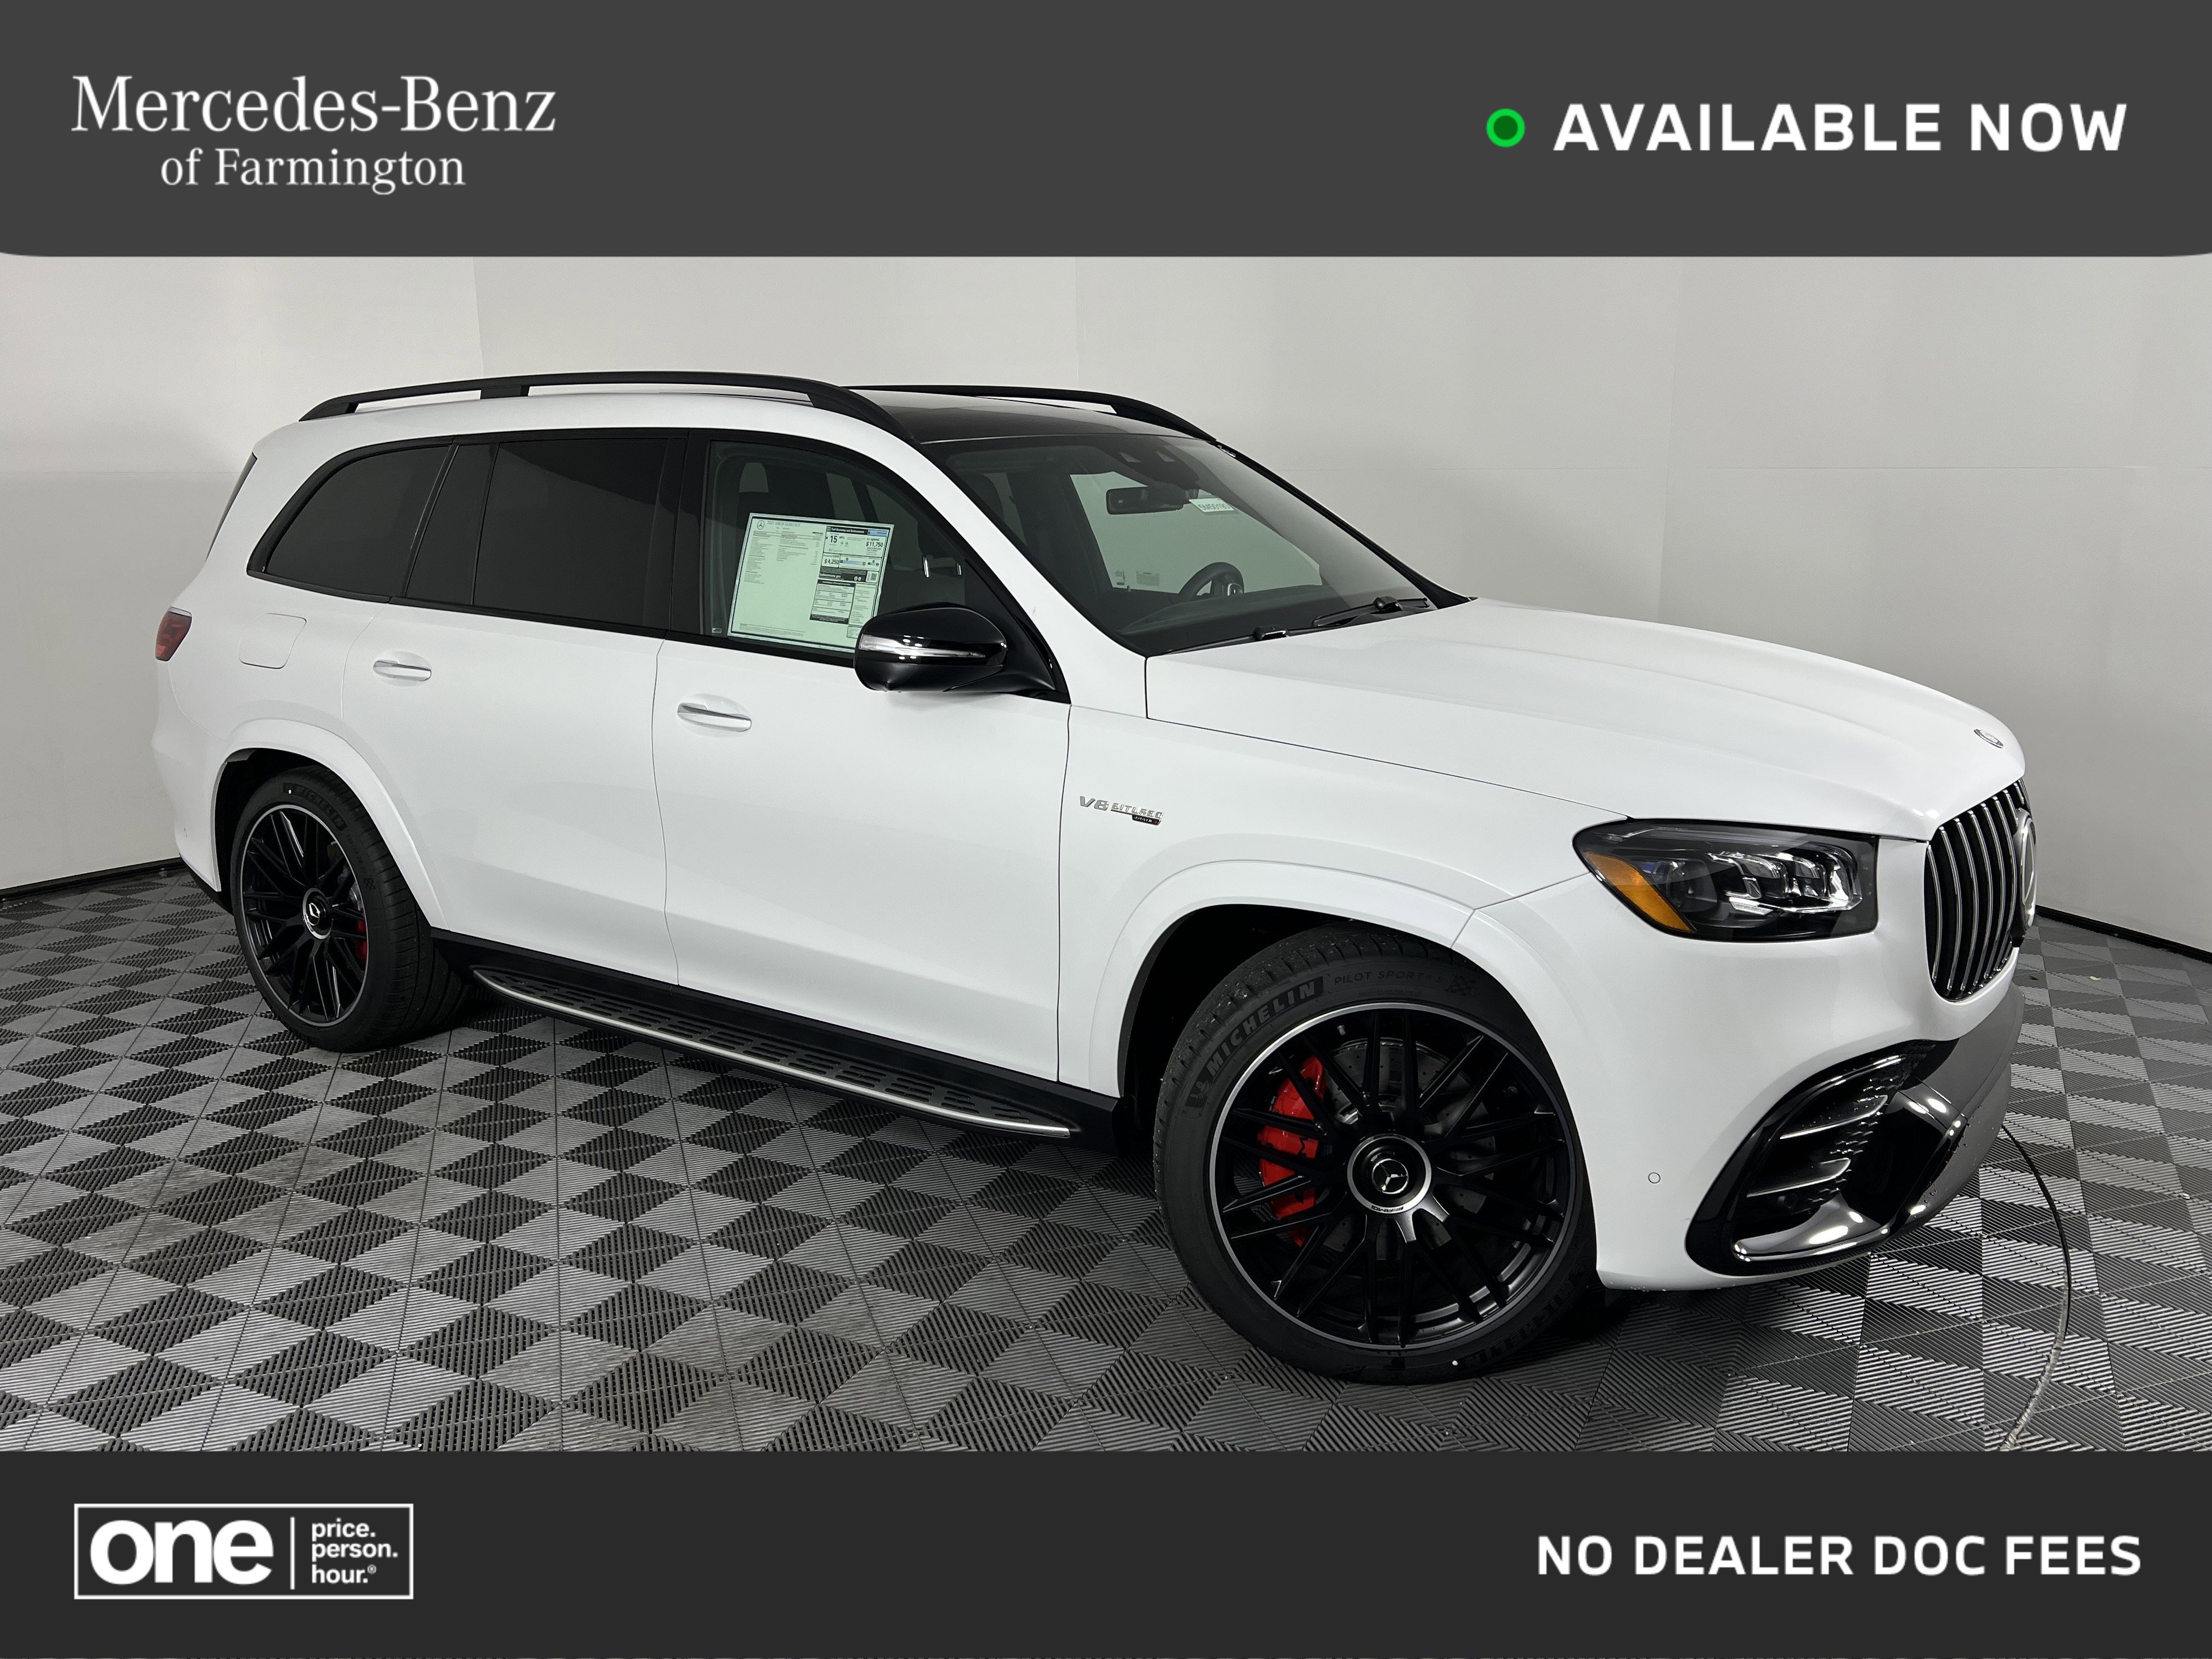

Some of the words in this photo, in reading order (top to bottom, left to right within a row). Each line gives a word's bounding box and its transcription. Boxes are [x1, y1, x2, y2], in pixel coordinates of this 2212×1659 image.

[1080, 795, 1109, 811] V8
[1111, 802, 1164, 820] BITURBO
[1334, 971, 1372, 986] PILOT
[1378, 970, 1425, 981] SPORT
[1205, 981, 1316, 1078] MICHELIN
